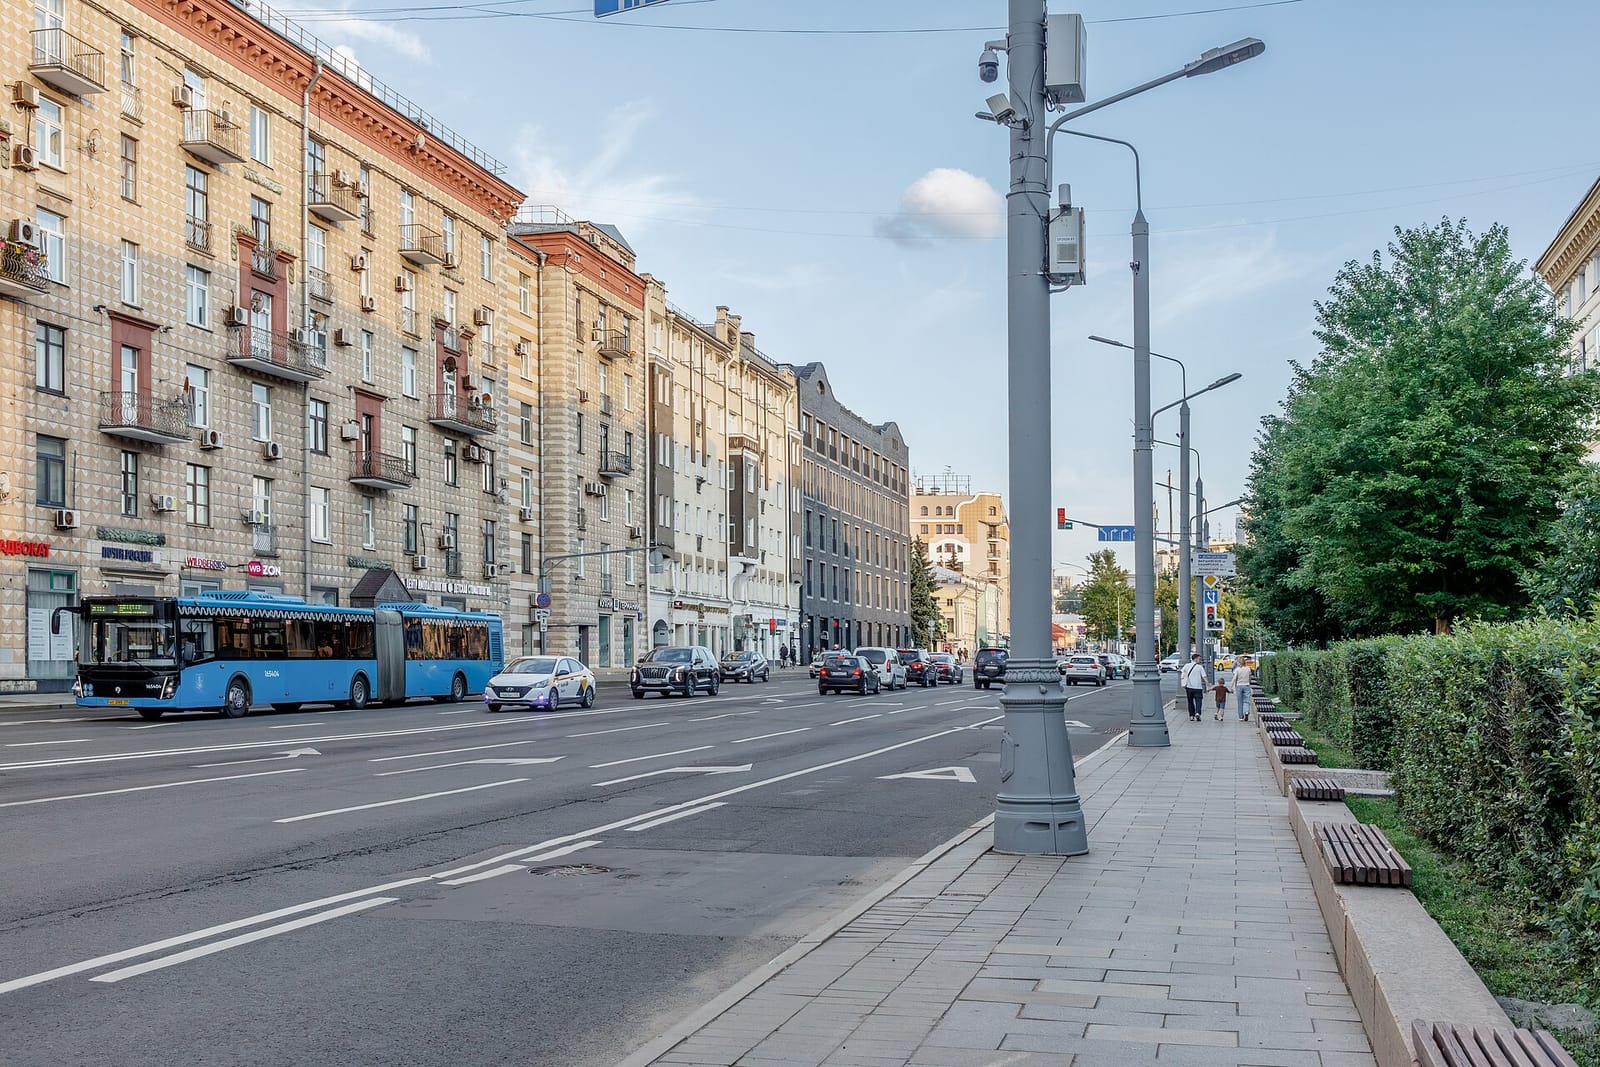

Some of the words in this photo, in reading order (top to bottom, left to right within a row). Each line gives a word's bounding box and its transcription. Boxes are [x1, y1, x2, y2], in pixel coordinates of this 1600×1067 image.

[102, 546, 124, 560] ПОЧТА
[249, 564, 262, 573] WB
[262, 564, 281, 576] ZON
